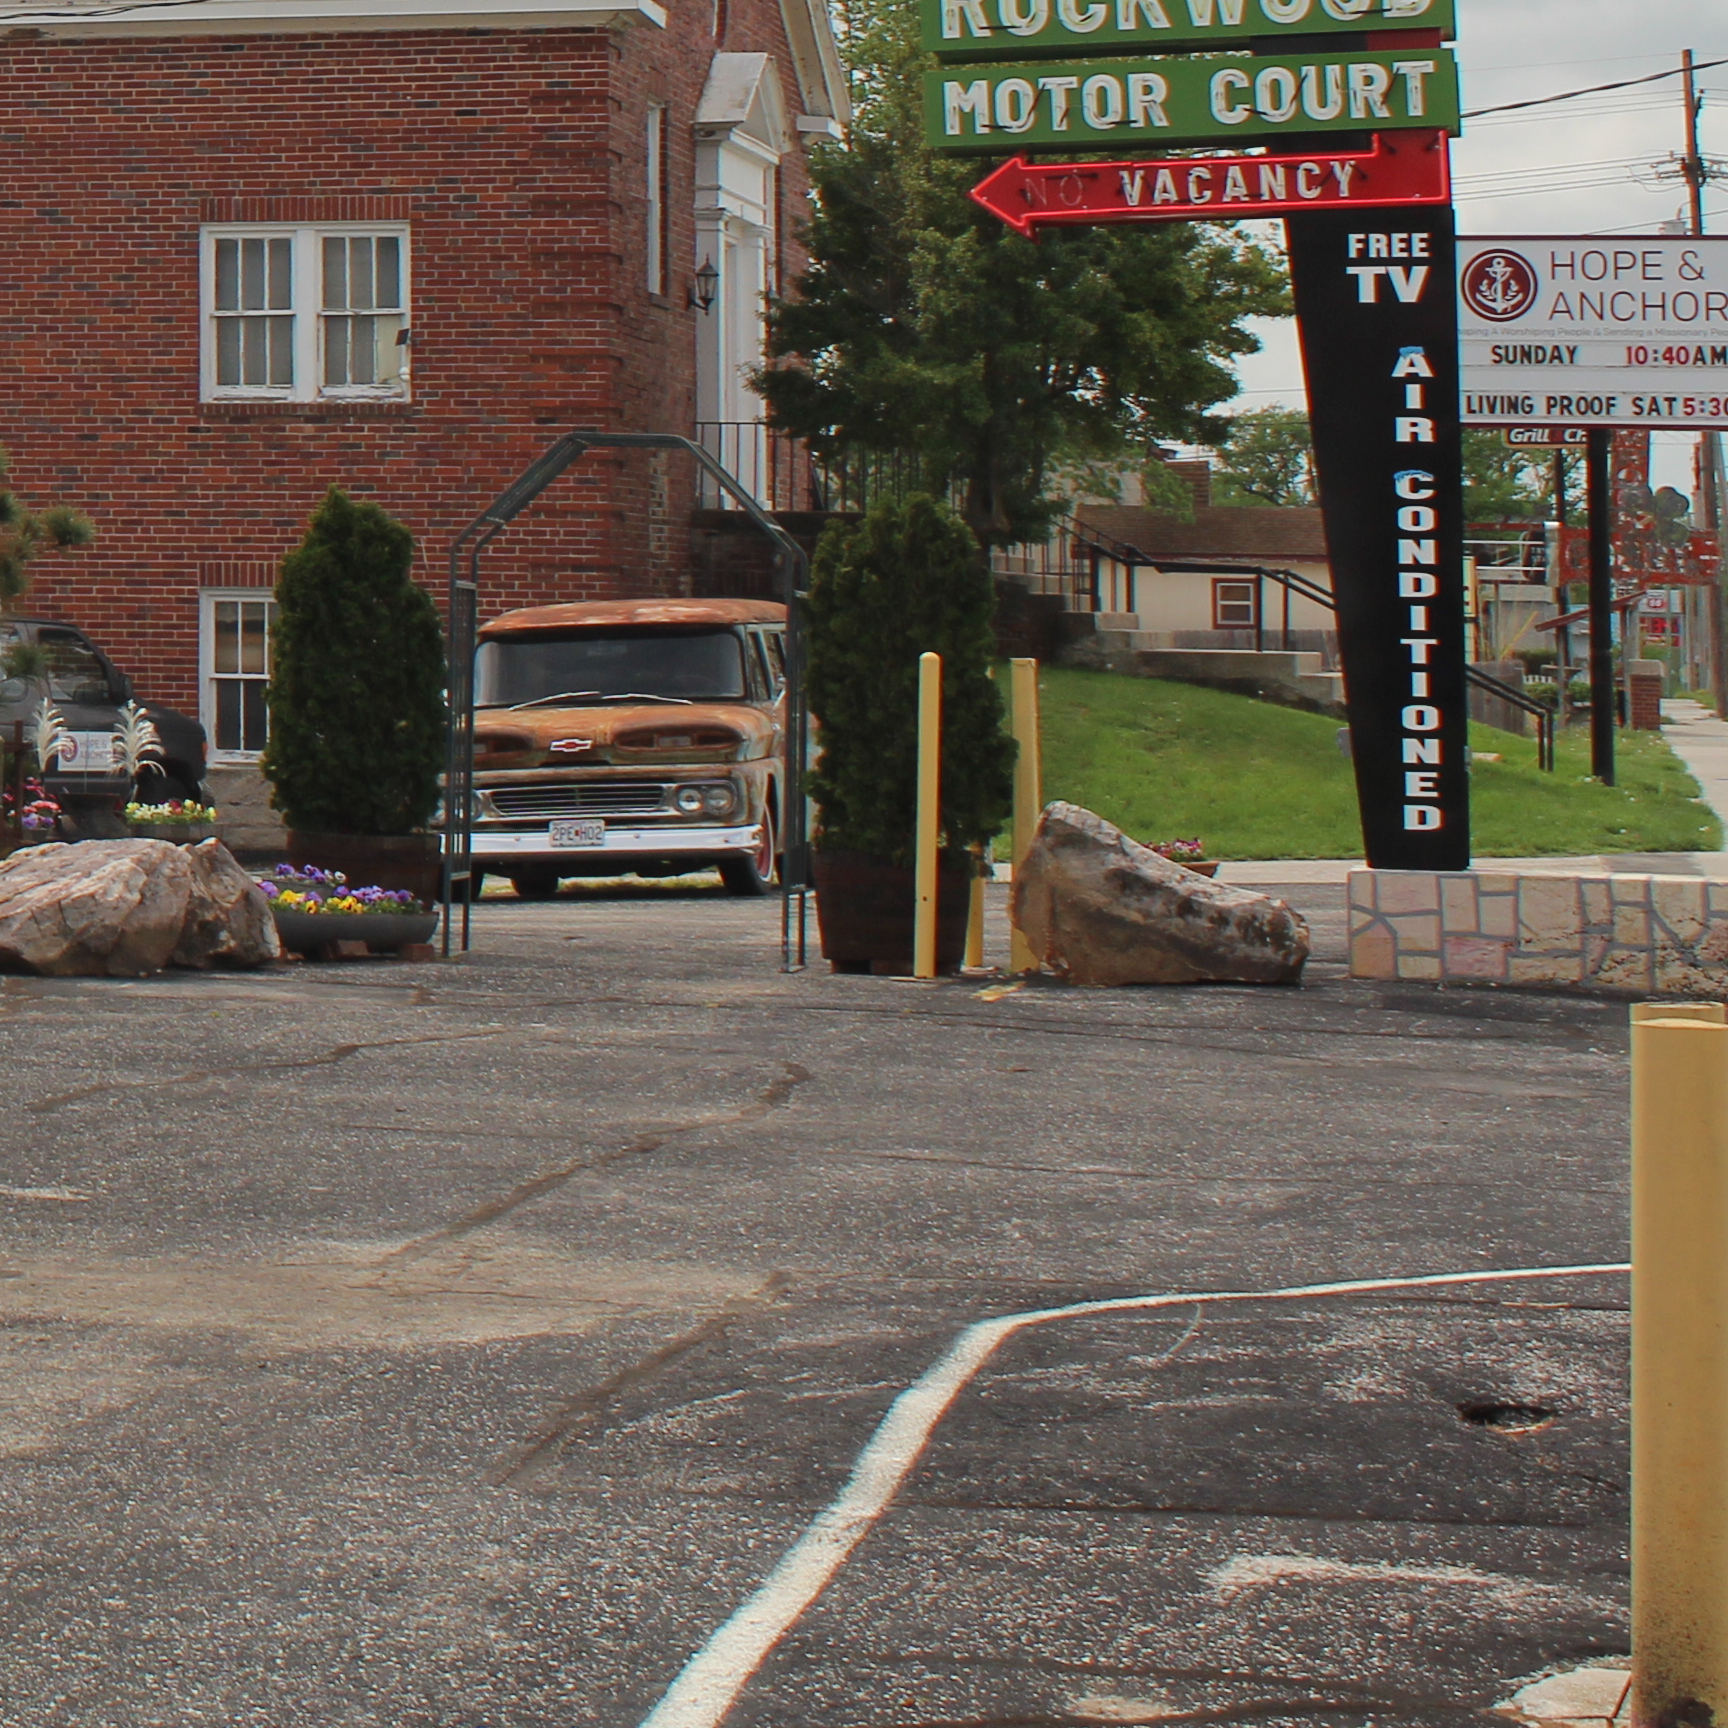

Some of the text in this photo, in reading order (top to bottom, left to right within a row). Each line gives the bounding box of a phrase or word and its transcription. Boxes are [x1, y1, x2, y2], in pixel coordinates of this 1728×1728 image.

[944, 60, 1436, 136] MOTOR COURT
[1118, 160, 1356, 207] VACANCY
[1347, 232, 1430, 258] FREE
[1550, 250, 1705, 282] HOPE &
[1346, 265, 1430, 304] TV
[1548, 290, 1728, 322] ANCHOR
[1490, 344, 1579, 364] SUNDAY
[1391, 346, 1434, 443] AIR
[1465, 395, 1534, 415] LIVING
[1545, 396, 1617, 415] PROOF
[1509, 428, 1550, 442] Grill
[1393, 470, 1442, 832] CONDITIONED
